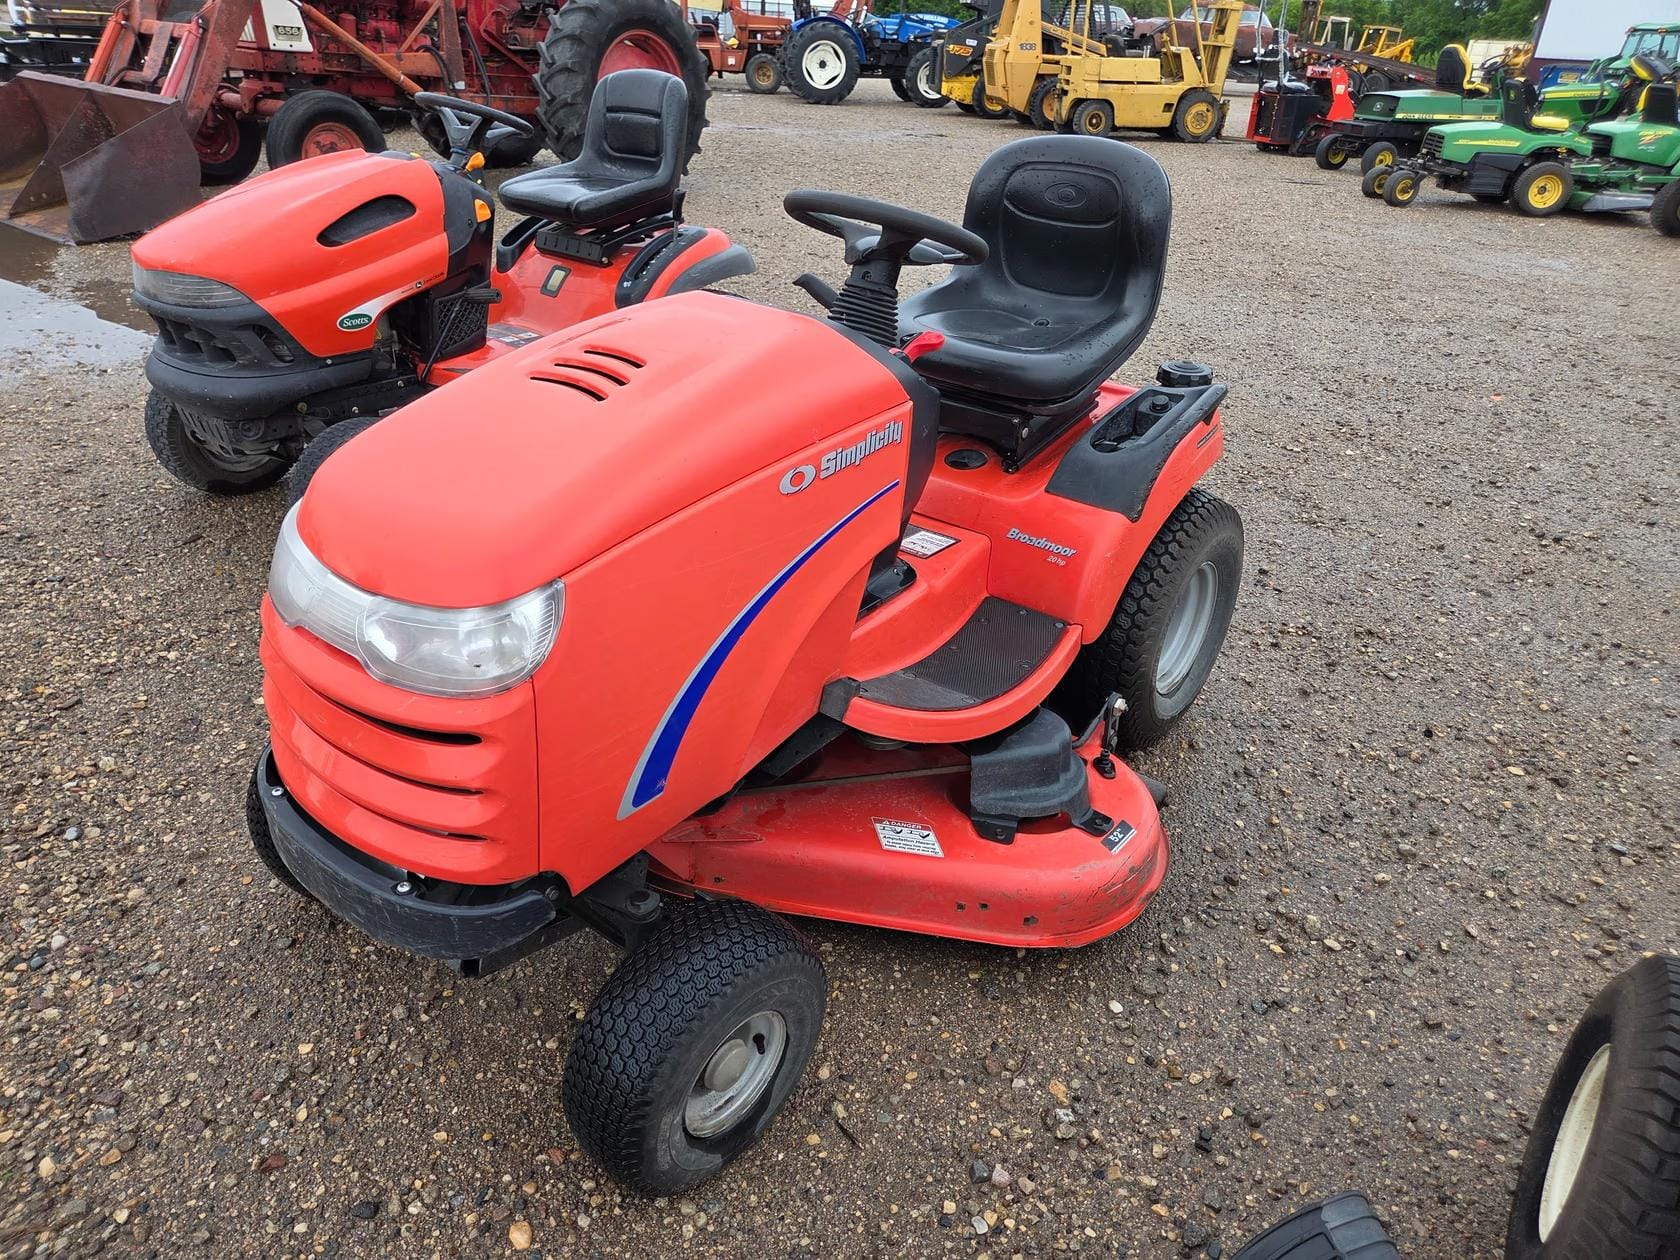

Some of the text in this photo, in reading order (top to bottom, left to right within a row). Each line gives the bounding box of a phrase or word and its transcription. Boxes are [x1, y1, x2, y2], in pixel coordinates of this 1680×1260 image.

[278, 26, 299, 36] 656
[343, 316, 369, 327] Scotts
[819, 420, 904, 480] Simplicity
[1006, 527, 1077, 557] Broadmoor
[1047, 555, 1058, 563] 20
[890, 821, 922, 829] DANGER
